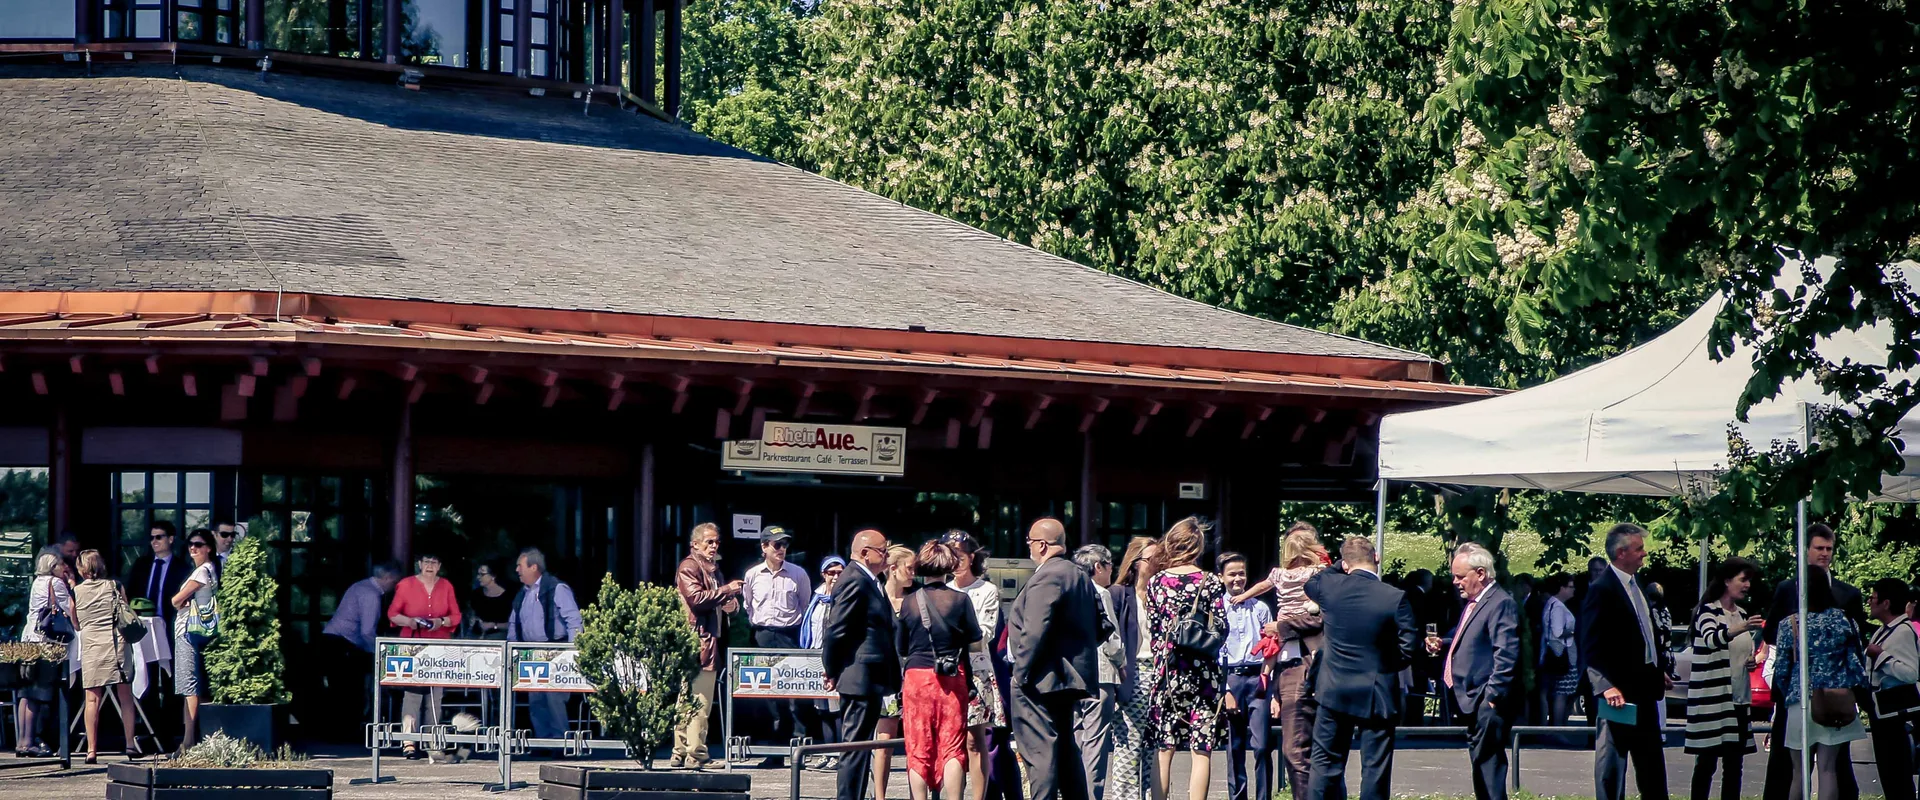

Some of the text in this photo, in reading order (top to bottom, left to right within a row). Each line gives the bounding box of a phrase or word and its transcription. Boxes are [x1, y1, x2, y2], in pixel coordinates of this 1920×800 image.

[773, 426, 855, 450] RheinAue
[762, 453, 868, 465] Parkrestaurant Café Terrassen
[418, 658, 466, 668] Volksbank
[418, 670, 496, 683] Bonn Rhein-Sieg
[555, 674, 582, 684] Bonn
[777, 681, 805, 690] Bonn
